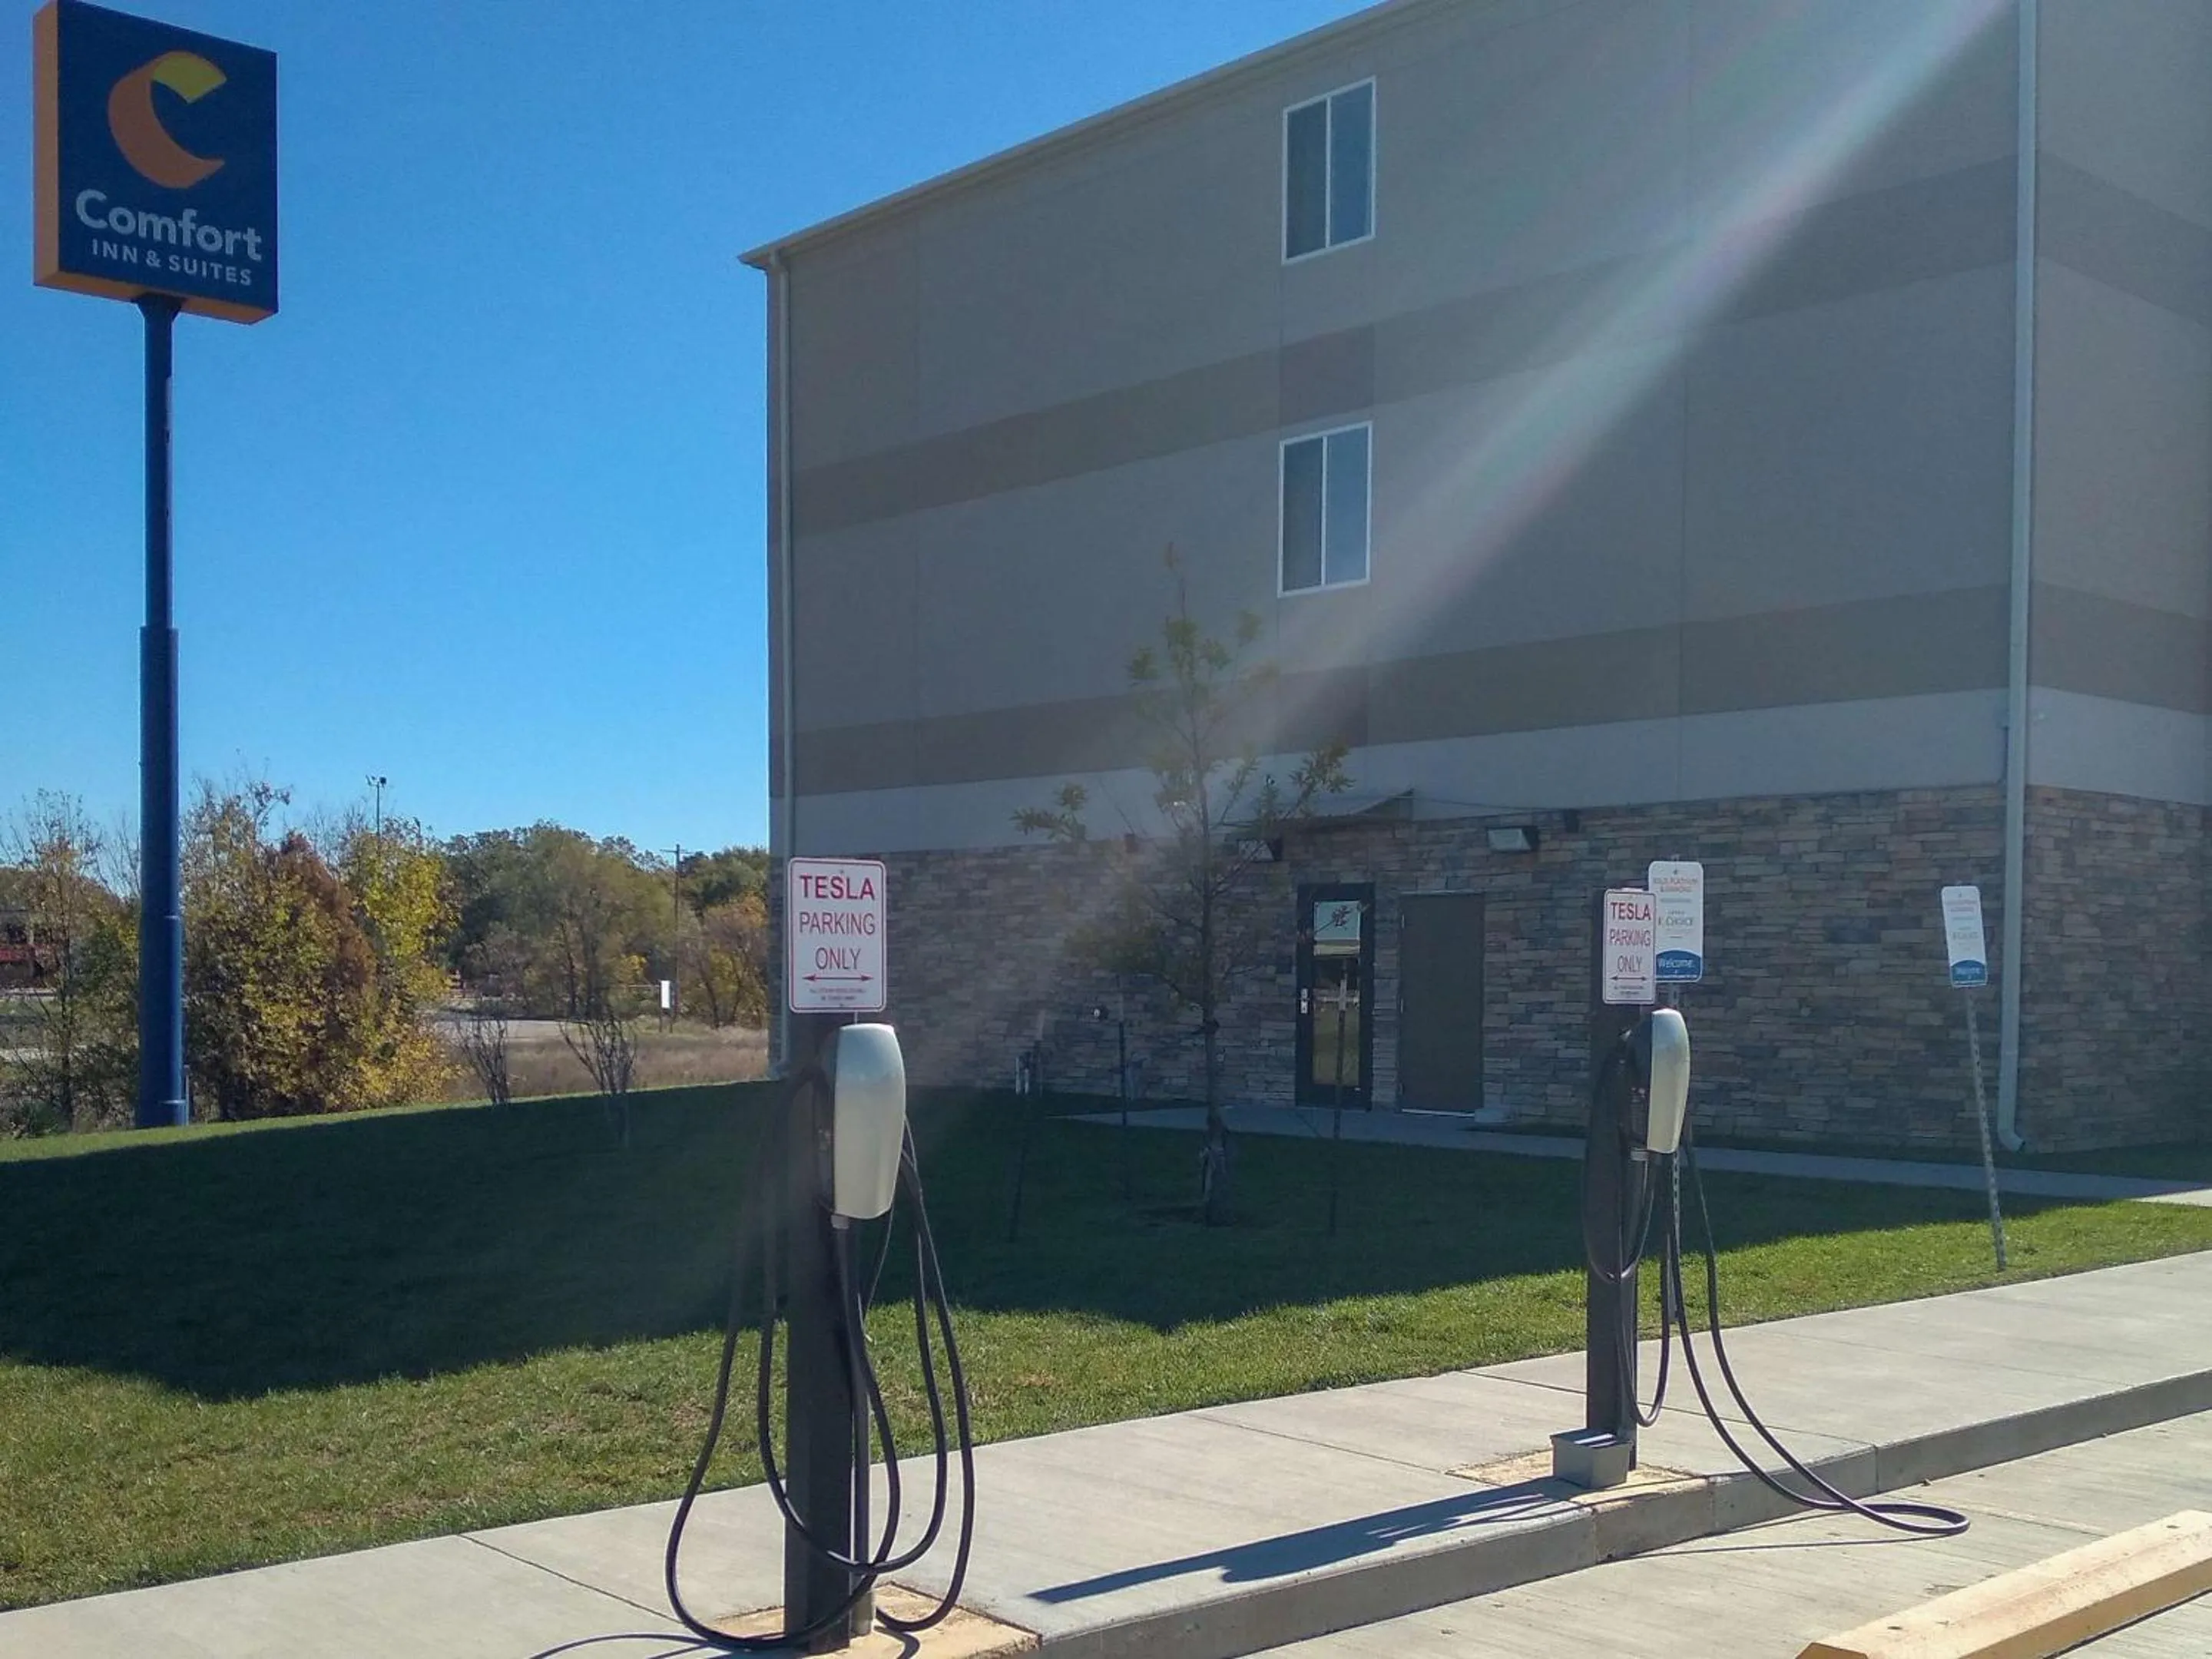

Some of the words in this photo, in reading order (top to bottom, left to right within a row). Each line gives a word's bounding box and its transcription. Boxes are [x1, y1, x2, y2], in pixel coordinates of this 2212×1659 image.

[76, 188, 262, 261] Comfort
[92, 239, 137, 264] INN
[145, 250, 162, 268] &
[169, 254, 253, 286] SUITES
[800, 876, 876, 901] TESLA
[1610, 902, 1651, 921] TESLA
[800, 912, 876, 935] PARKING
[1609, 929, 1651, 947] PARKING
[815, 947, 862, 970] ONLY
[1617, 955, 1644, 973] ONLY
